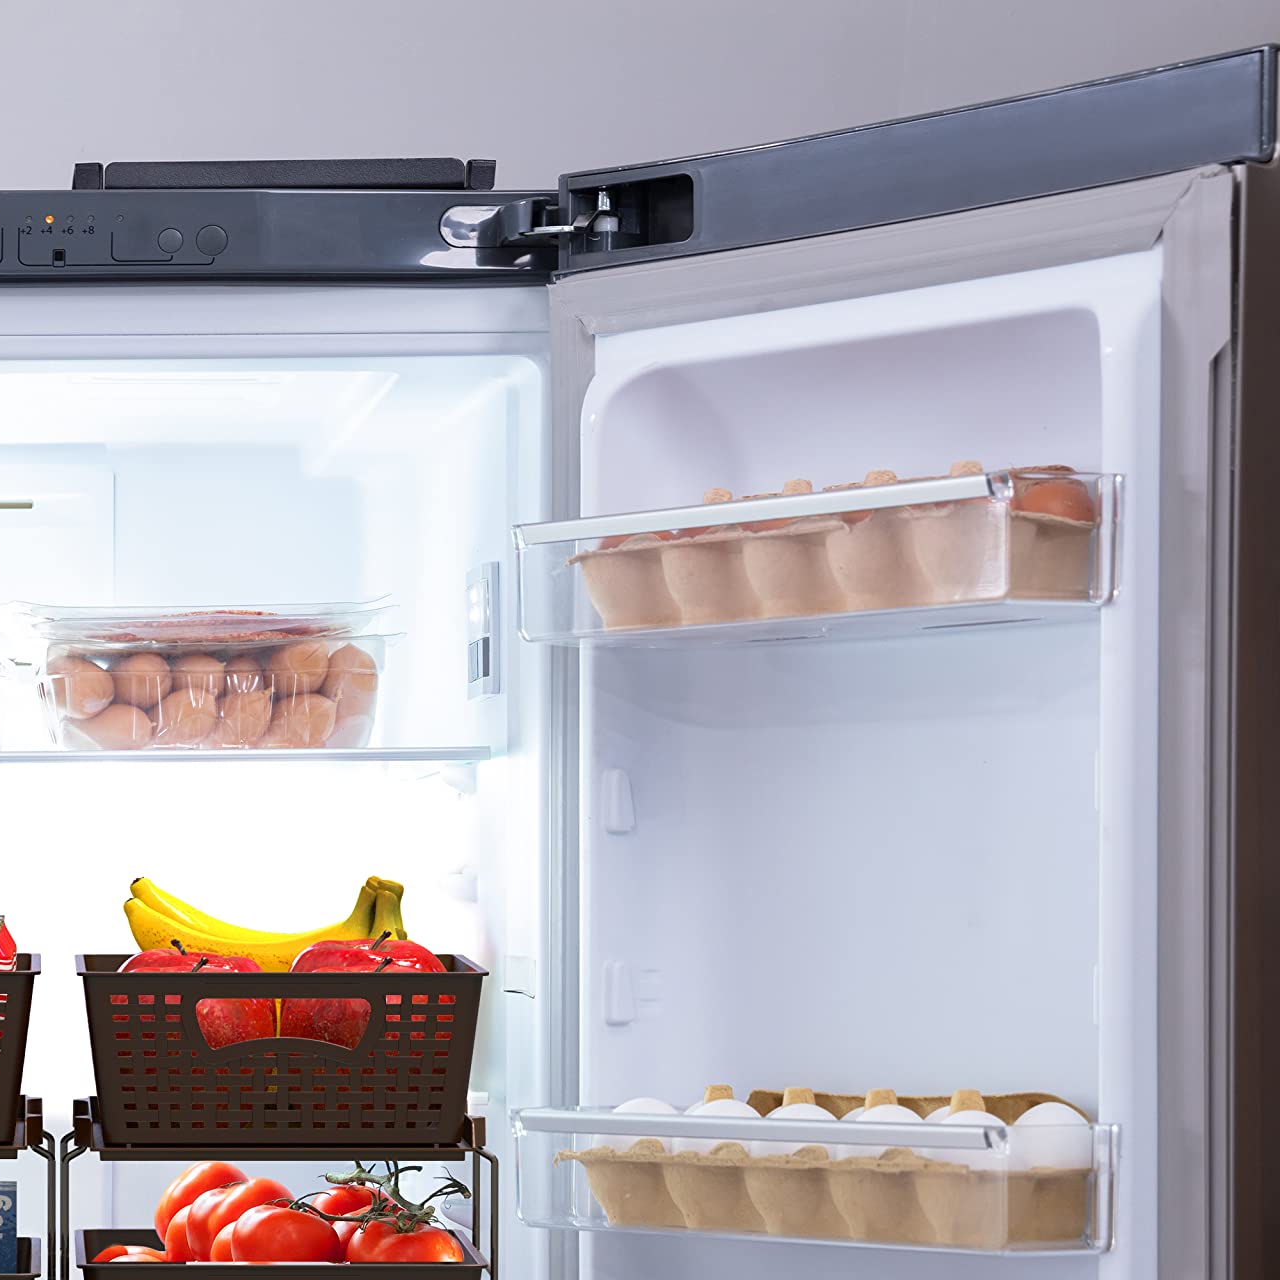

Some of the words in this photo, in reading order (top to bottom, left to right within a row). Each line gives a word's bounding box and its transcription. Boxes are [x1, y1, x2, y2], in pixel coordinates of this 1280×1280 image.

[20, 226, 32, 235] +2
[40, 226, 53, 235] +4
[61, 226, 74, 235] +6
[81, 226, 95, 235] +8
